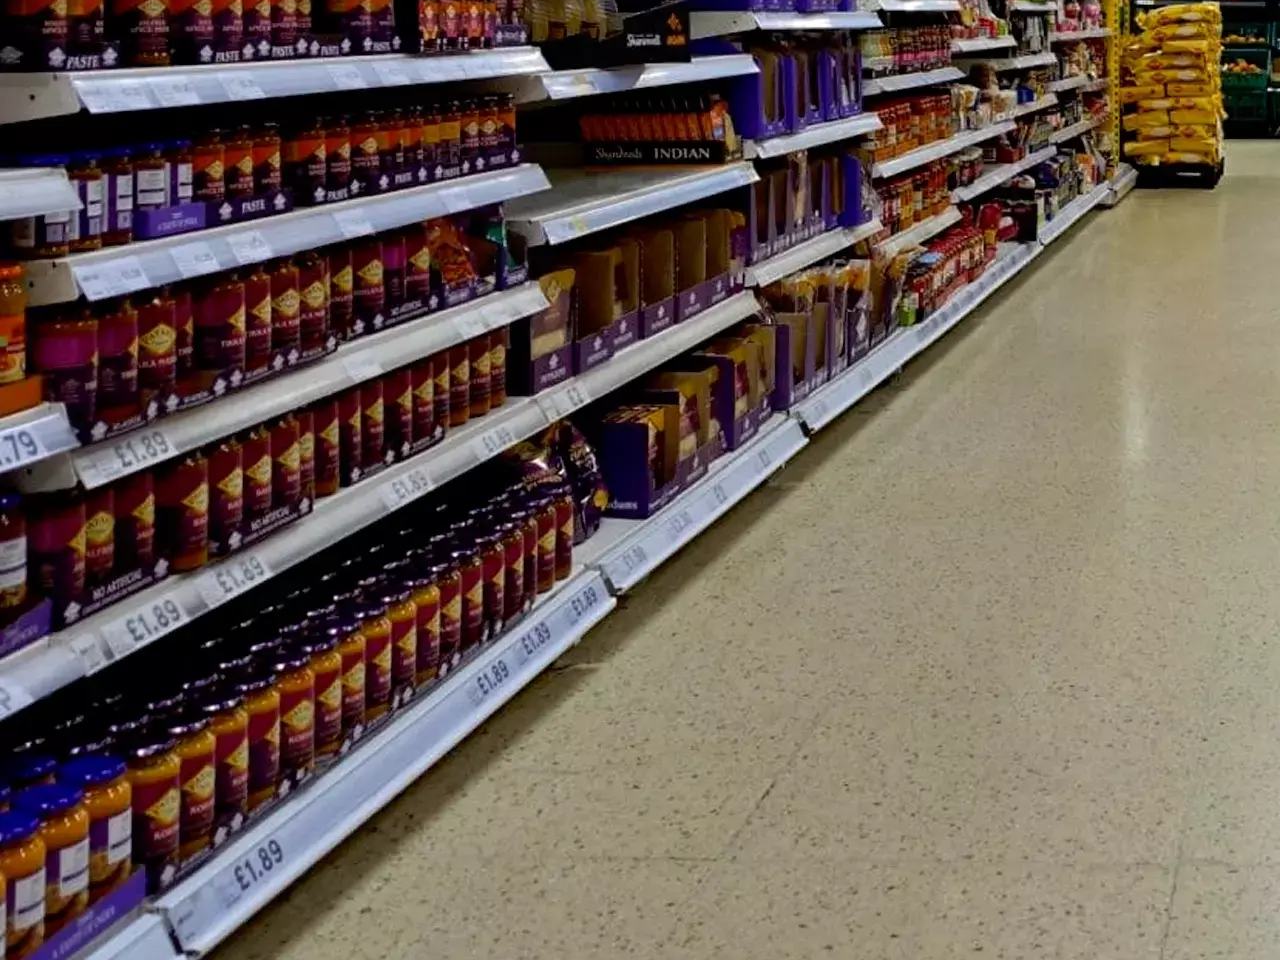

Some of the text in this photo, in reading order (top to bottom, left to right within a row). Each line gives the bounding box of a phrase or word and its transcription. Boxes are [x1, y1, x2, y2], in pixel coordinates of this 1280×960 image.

[66, 55, 100, 70] PASTE
[654, 147, 710, 159] INDIAN
[115, 431, 170, 468] £1.89
[216, 556, 264, 594] £1.89
[126, 600, 181, 643] £1.89
[477, 659, 510, 695] £1.89
[234, 839, 283, 891] £1.89
